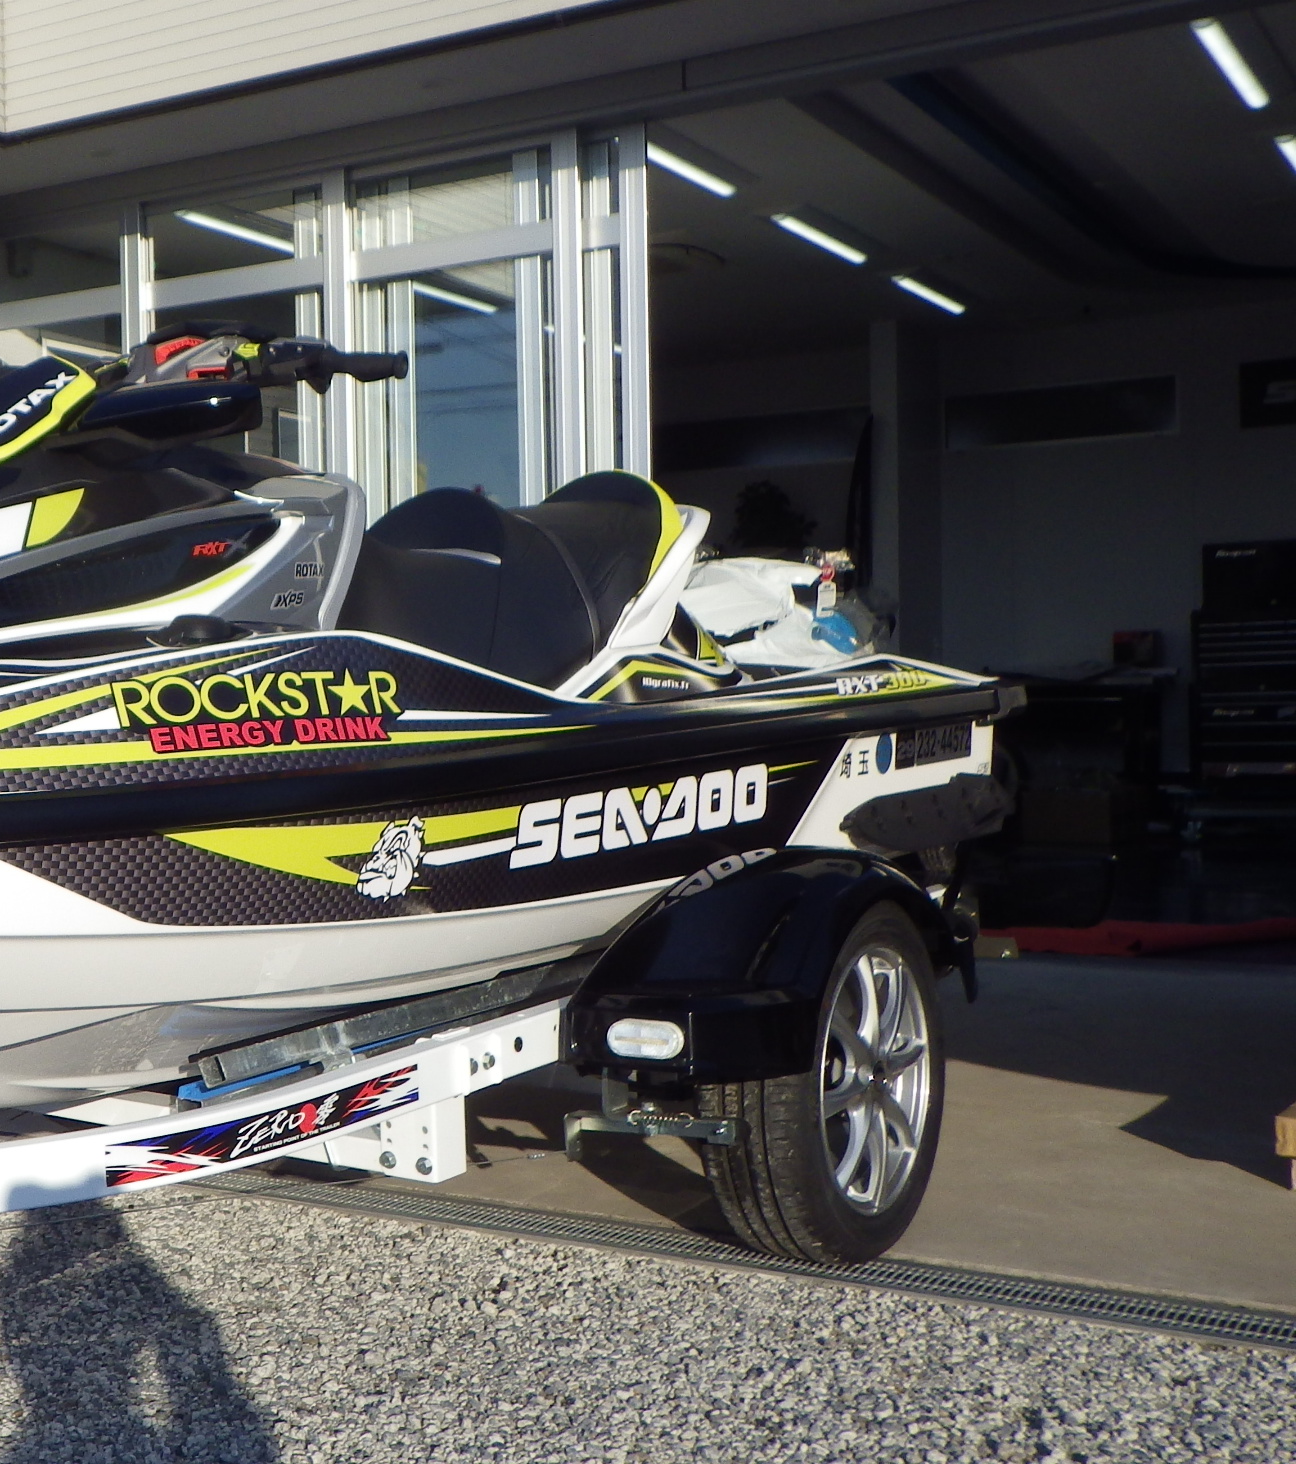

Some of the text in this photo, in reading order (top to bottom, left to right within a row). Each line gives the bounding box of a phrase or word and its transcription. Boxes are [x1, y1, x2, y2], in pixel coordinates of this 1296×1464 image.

[295, 562, 324, 578] ROTAX
[150, 716, 389, 753] ENERGY DRINK
[253, 1140, 283, 1152] STARTING
[284, 1134, 300, 1144] POINT
